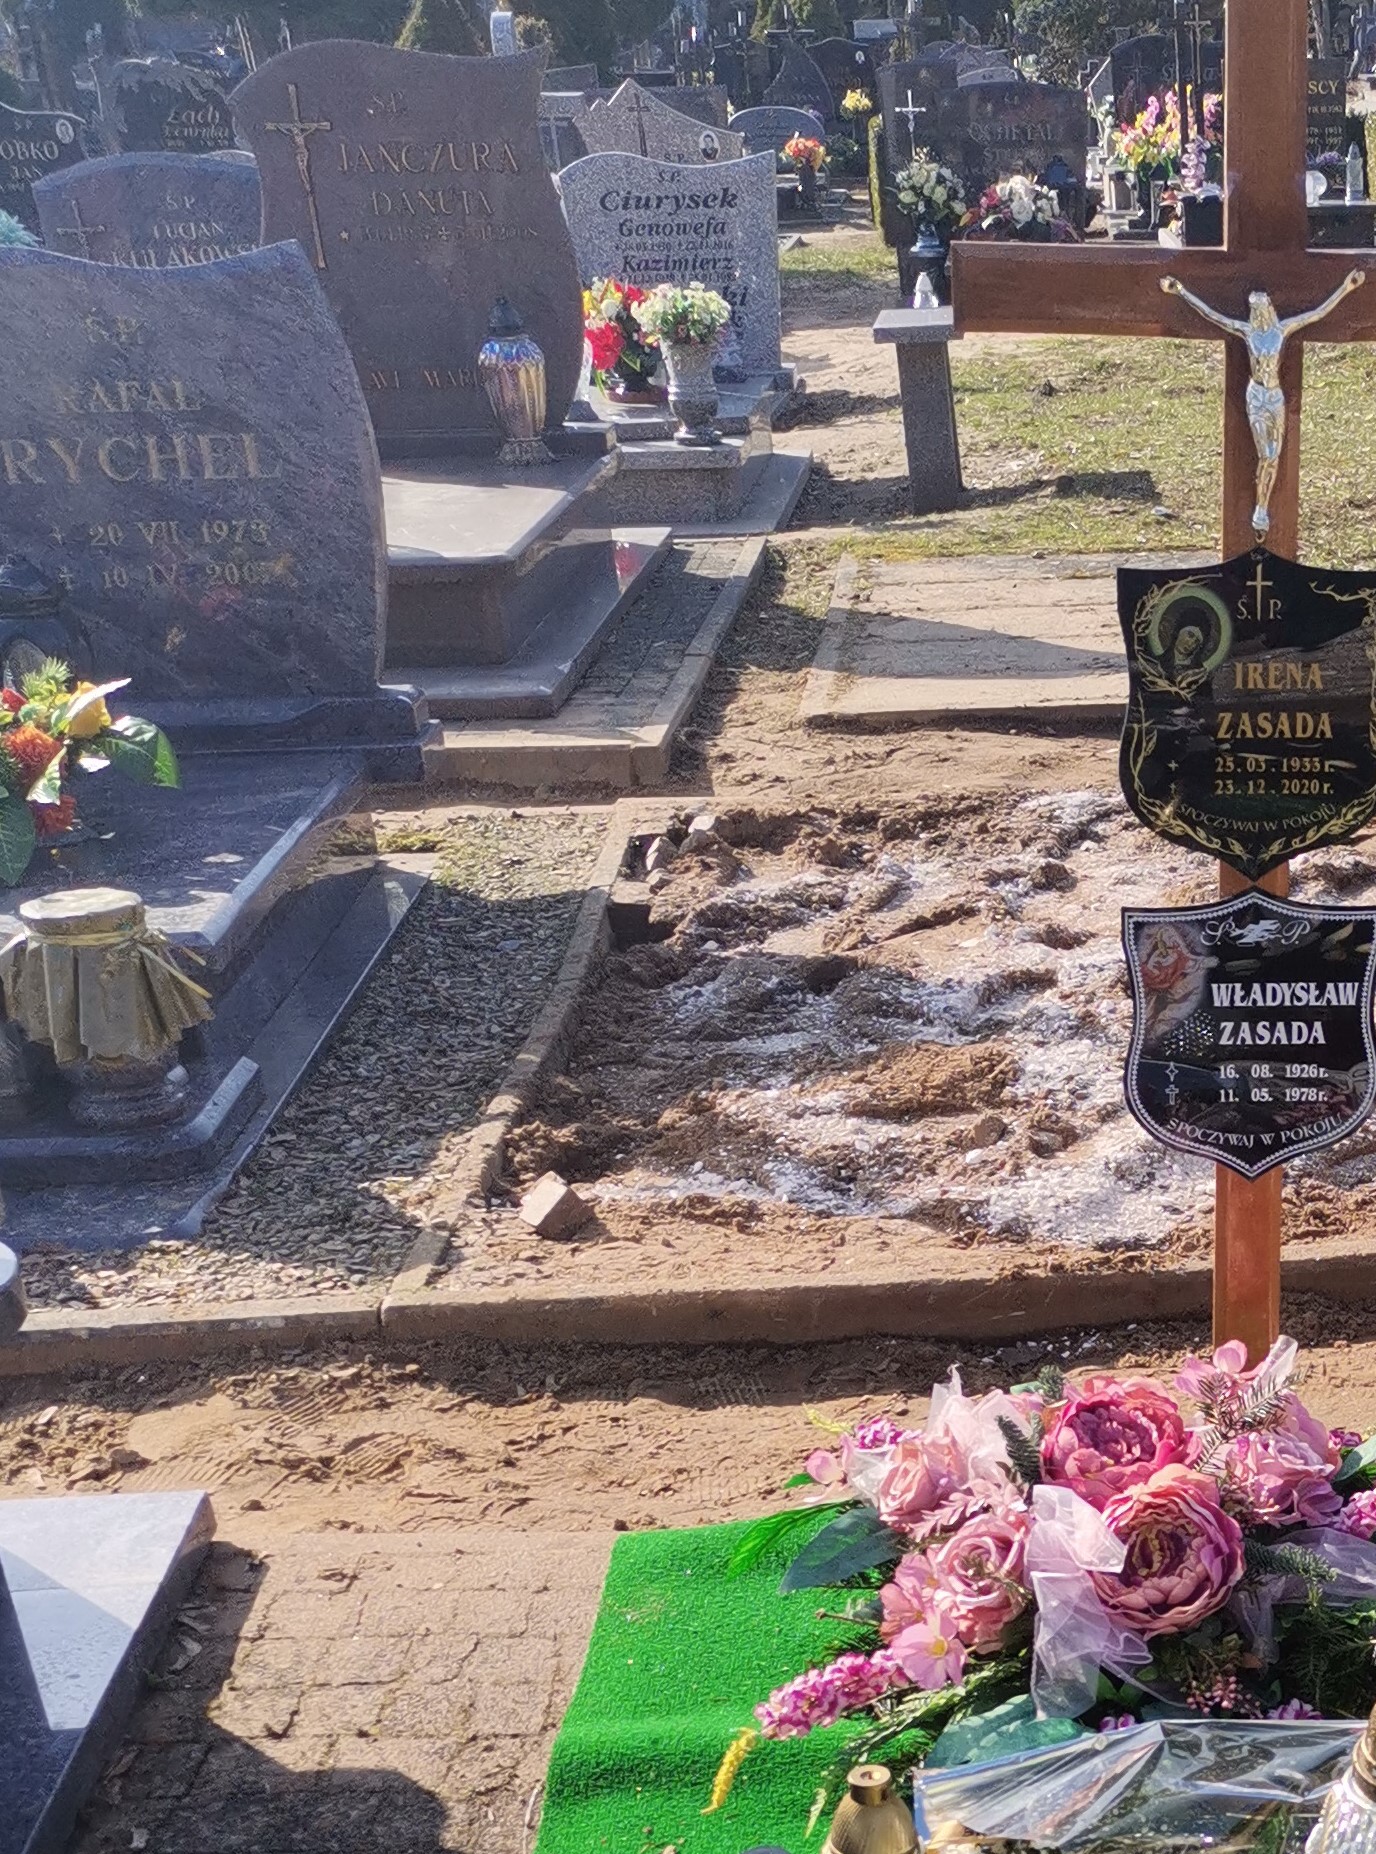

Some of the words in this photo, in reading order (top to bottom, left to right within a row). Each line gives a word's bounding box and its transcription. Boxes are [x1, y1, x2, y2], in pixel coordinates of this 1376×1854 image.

[337, 141, 520, 174] JANCZURA
[371, 190, 495, 216] DANUTA
[600, 187, 739, 217] Ciurysek
[618, 217, 727, 239] Genowefa
[621, 253, 734, 273] Kazimierz
[1, 433, 283, 487] RYCHEL
[89, 522, 126, 547] 20
[1234, 661, 1323, 690] IRENA
[1216, 712, 1333, 740] ZASADA
[1177, 803, 1259, 833] SPOCZYWAJ
[1263, 820, 1279, 831] W
[1282, 802, 1338, 830] POKOJU
[1210, 981, 1359, 1008] WŁADYSŁAW
[1219, 1020, 1326, 1045] ZASADA
[1219, 1064, 1240, 1079] 16.
[1251, 1064, 1274, 1079] 08.
[1219, 1088, 1240, 1102] 11.
[1251, 1088, 1274, 1102] 05.
[1167, 1118, 1256, 1148] SPOCZYWAJ
[1259, 1134, 1276, 1147] W
[1281, 1114, 1344, 1146] POKOJU
